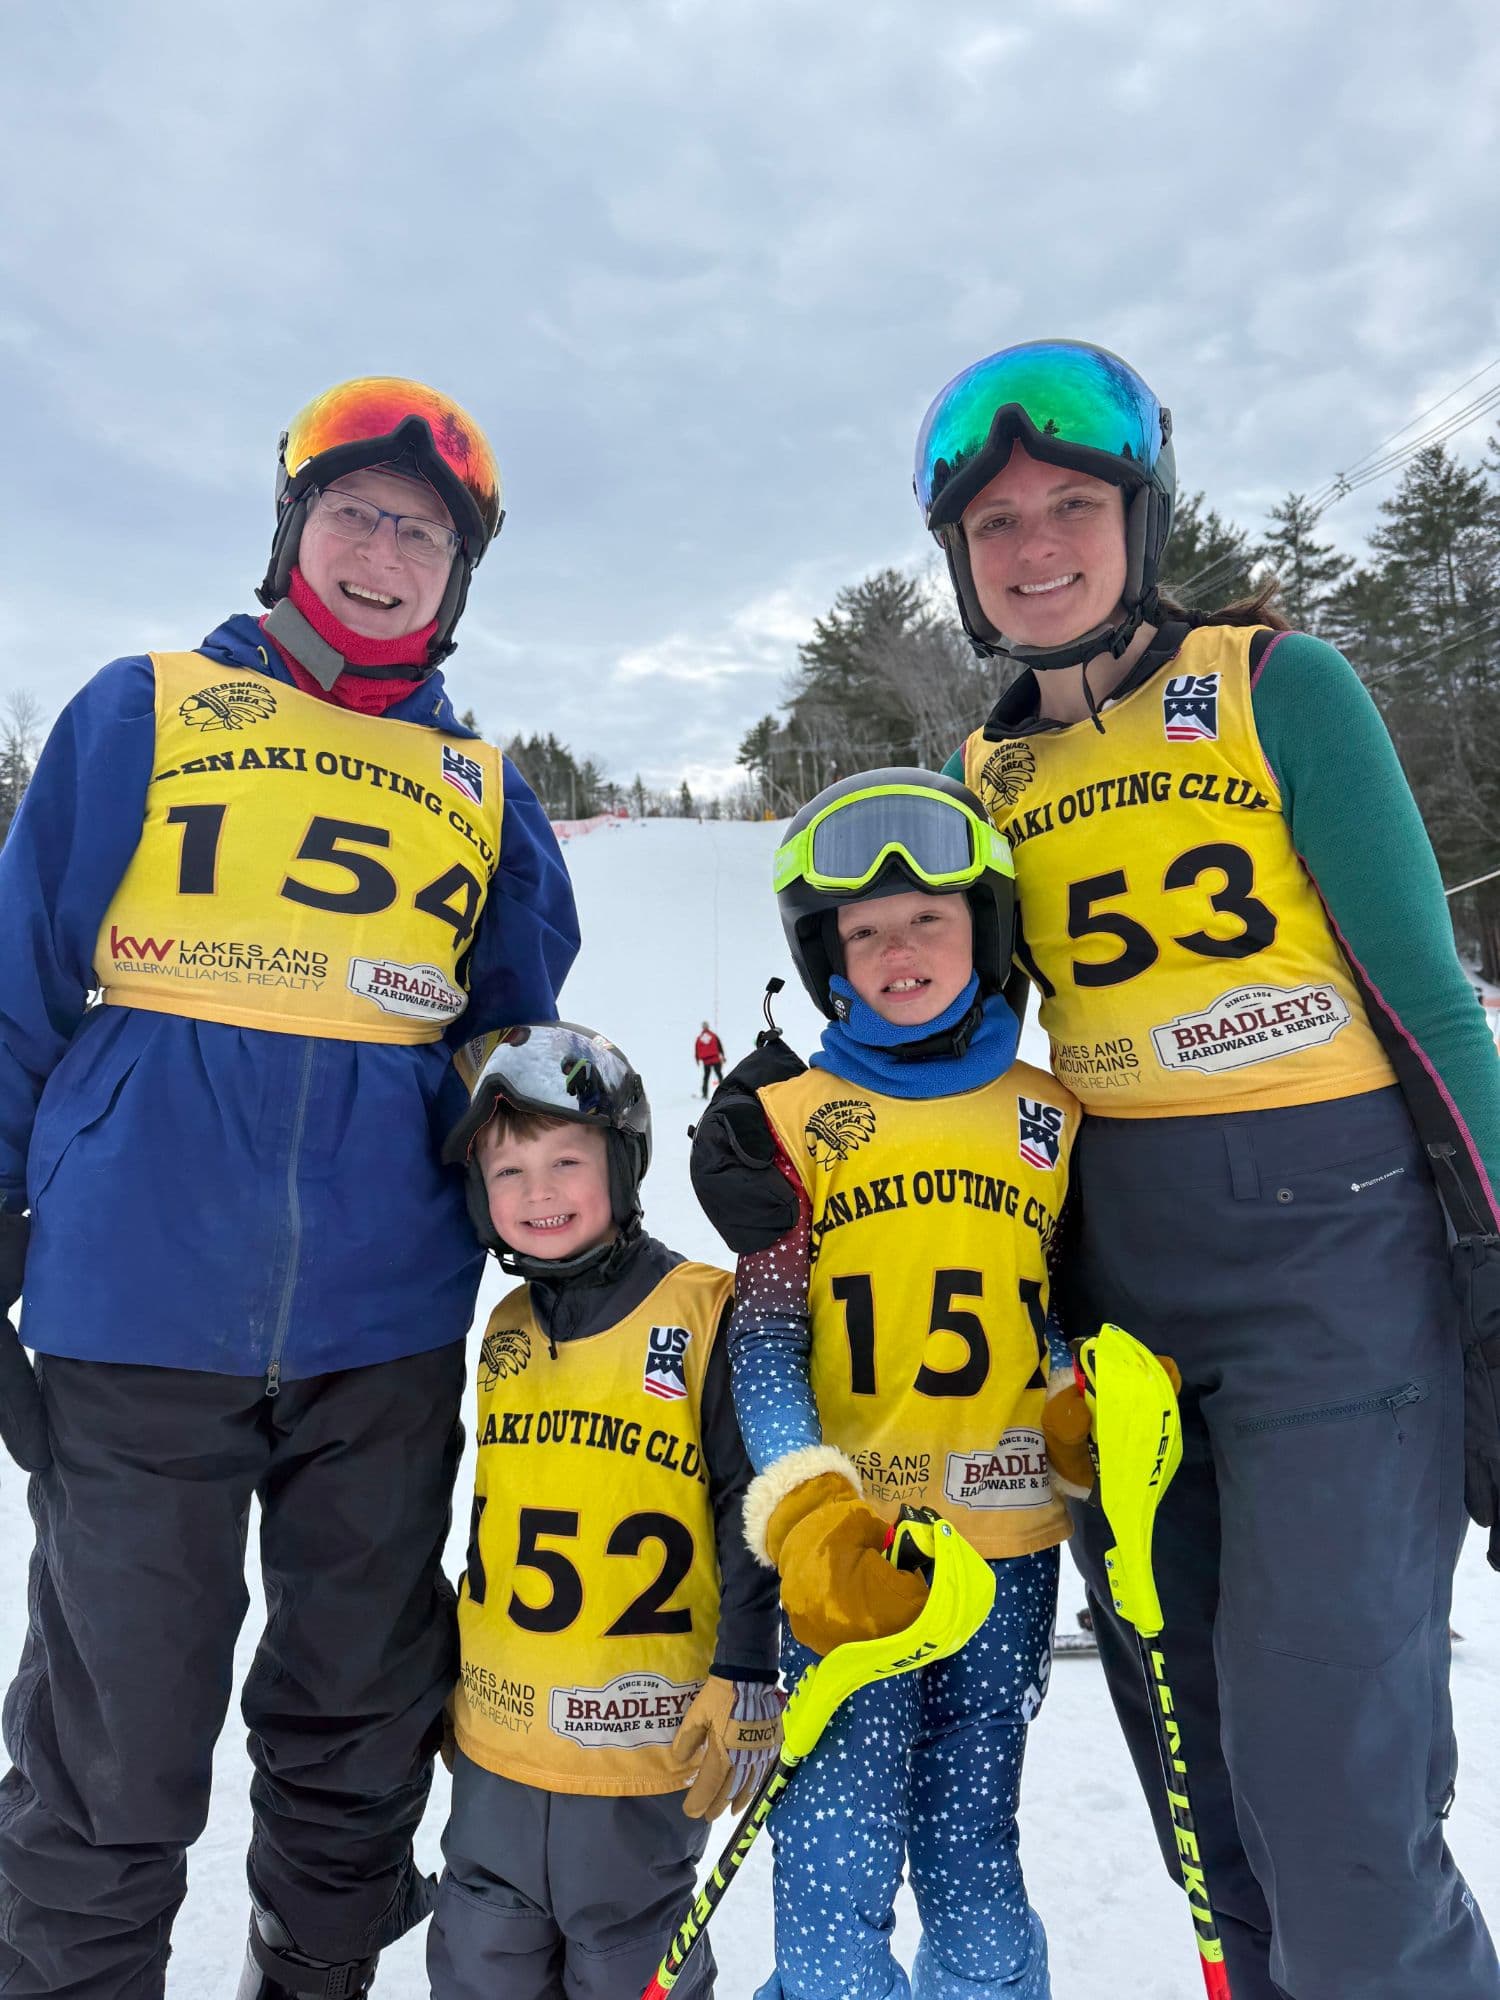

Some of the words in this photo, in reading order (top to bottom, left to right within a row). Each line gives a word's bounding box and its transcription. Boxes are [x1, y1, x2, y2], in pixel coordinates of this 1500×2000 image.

[210, 681, 262, 694] ABENAKI
[1165, 674, 1218, 697] US
[228, 695, 259, 705] AREA
[443, 745, 482, 777] US
[1001, 760, 1023, 773] AREA
[315, 751, 443, 816] OUTING
[1058, 771, 1171, 825] OUTING
[166, 803, 482, 951] 154
[179, 940, 263, 958] LAKES
[273, 947, 329, 965] AND
[179, 952, 327, 978] MOUNTAINS
[247, 973, 325, 992] REALTY
[367, 984, 430, 1008] HARDWARE
[1225, 993, 1250, 1009] SINCE
[1172, 991, 1332, 1050] BRADLEY'S
[1095, 1038, 1133, 1057] AND
[1178, 1032, 1268, 1062] HARDWARE
[1271, 1028, 1283, 1038] &
[1284, 1011, 1340, 1034] RENTAL
[1060, 1053, 1139, 1074] MOUNTAINS
[819, 1100, 863, 1119] ABENAKI
[834, 1109, 852, 1120] SKI
[1018, 1097, 1063, 1132] US
[912, 1168, 1019, 1217] OUTING
[649, 1328, 690, 1354] US
[536, 1410, 642, 1456] OUTING
[998, 1436, 1022, 1446] SINCE
[1149, 1410, 1171, 1487] LEKI
[889, 1453, 930, 1470] AND
[874, 1641, 938, 1673] LEKI
[501, 1678, 535, 1700] AND
[618, 1680, 641, 1691] SINCE
[564, 1720, 640, 1733] HARDWARE
[644, 1719, 654, 1729] &
